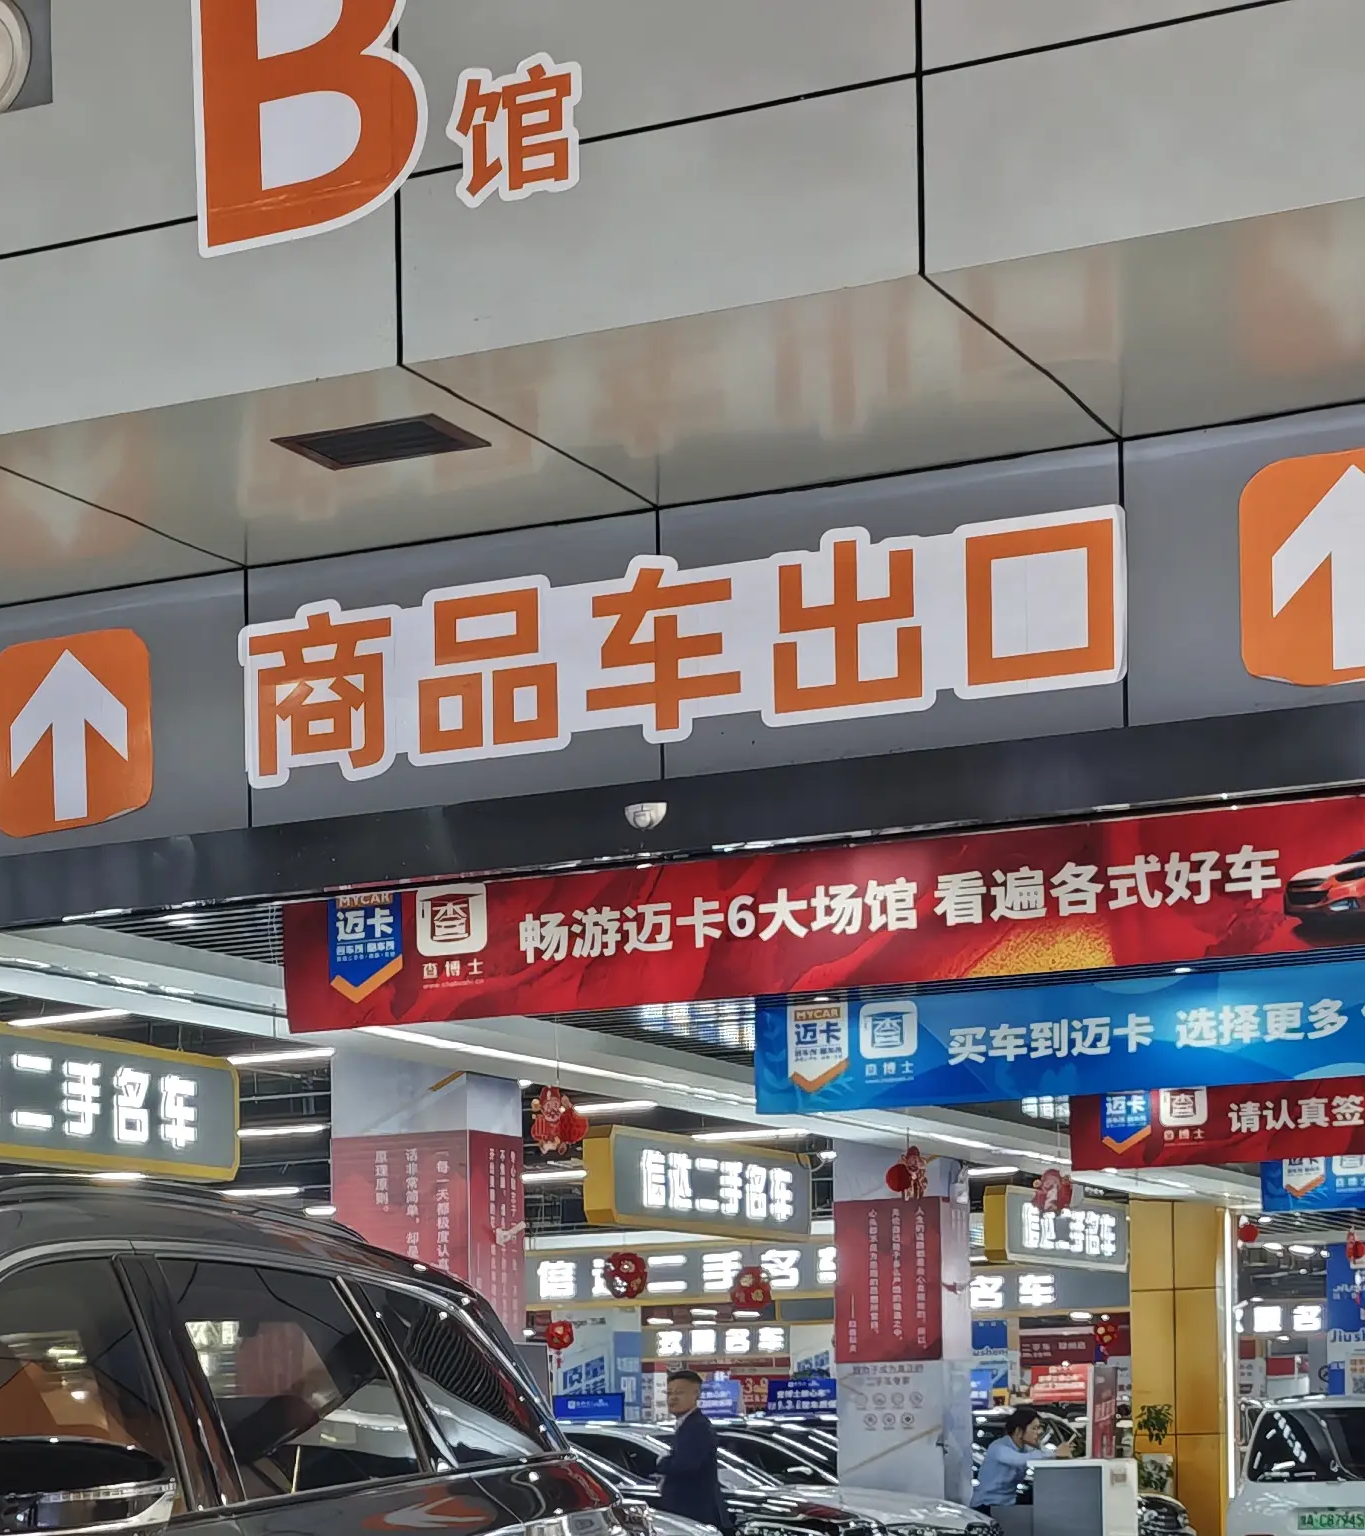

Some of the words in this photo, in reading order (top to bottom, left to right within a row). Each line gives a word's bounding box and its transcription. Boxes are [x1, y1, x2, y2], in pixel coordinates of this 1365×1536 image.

[196, 0, 423, 252] B
[449, 57, 579, 204] 馆
[244, 508, 1124, 782] 商品车出口
[336, 908, 394, 942] 迈卡
[517, 876, 920, 966] 畅游迈卡6大场馆
[931, 844, 1285, 927] 看遍各式好车
[422, 958, 484, 980] 查博士
[794, 1021, 842, 1046] 迈卡
[795, 1007, 840, 1021] MYCAR
[947, 1012, 1156, 1066] 买车到迈卡
[1175, 998, 1349, 1050] 选择更多
[1105, 1095, 1148, 1116] 迈卡
[639, 1147, 794, 1223] 信达二手名车
